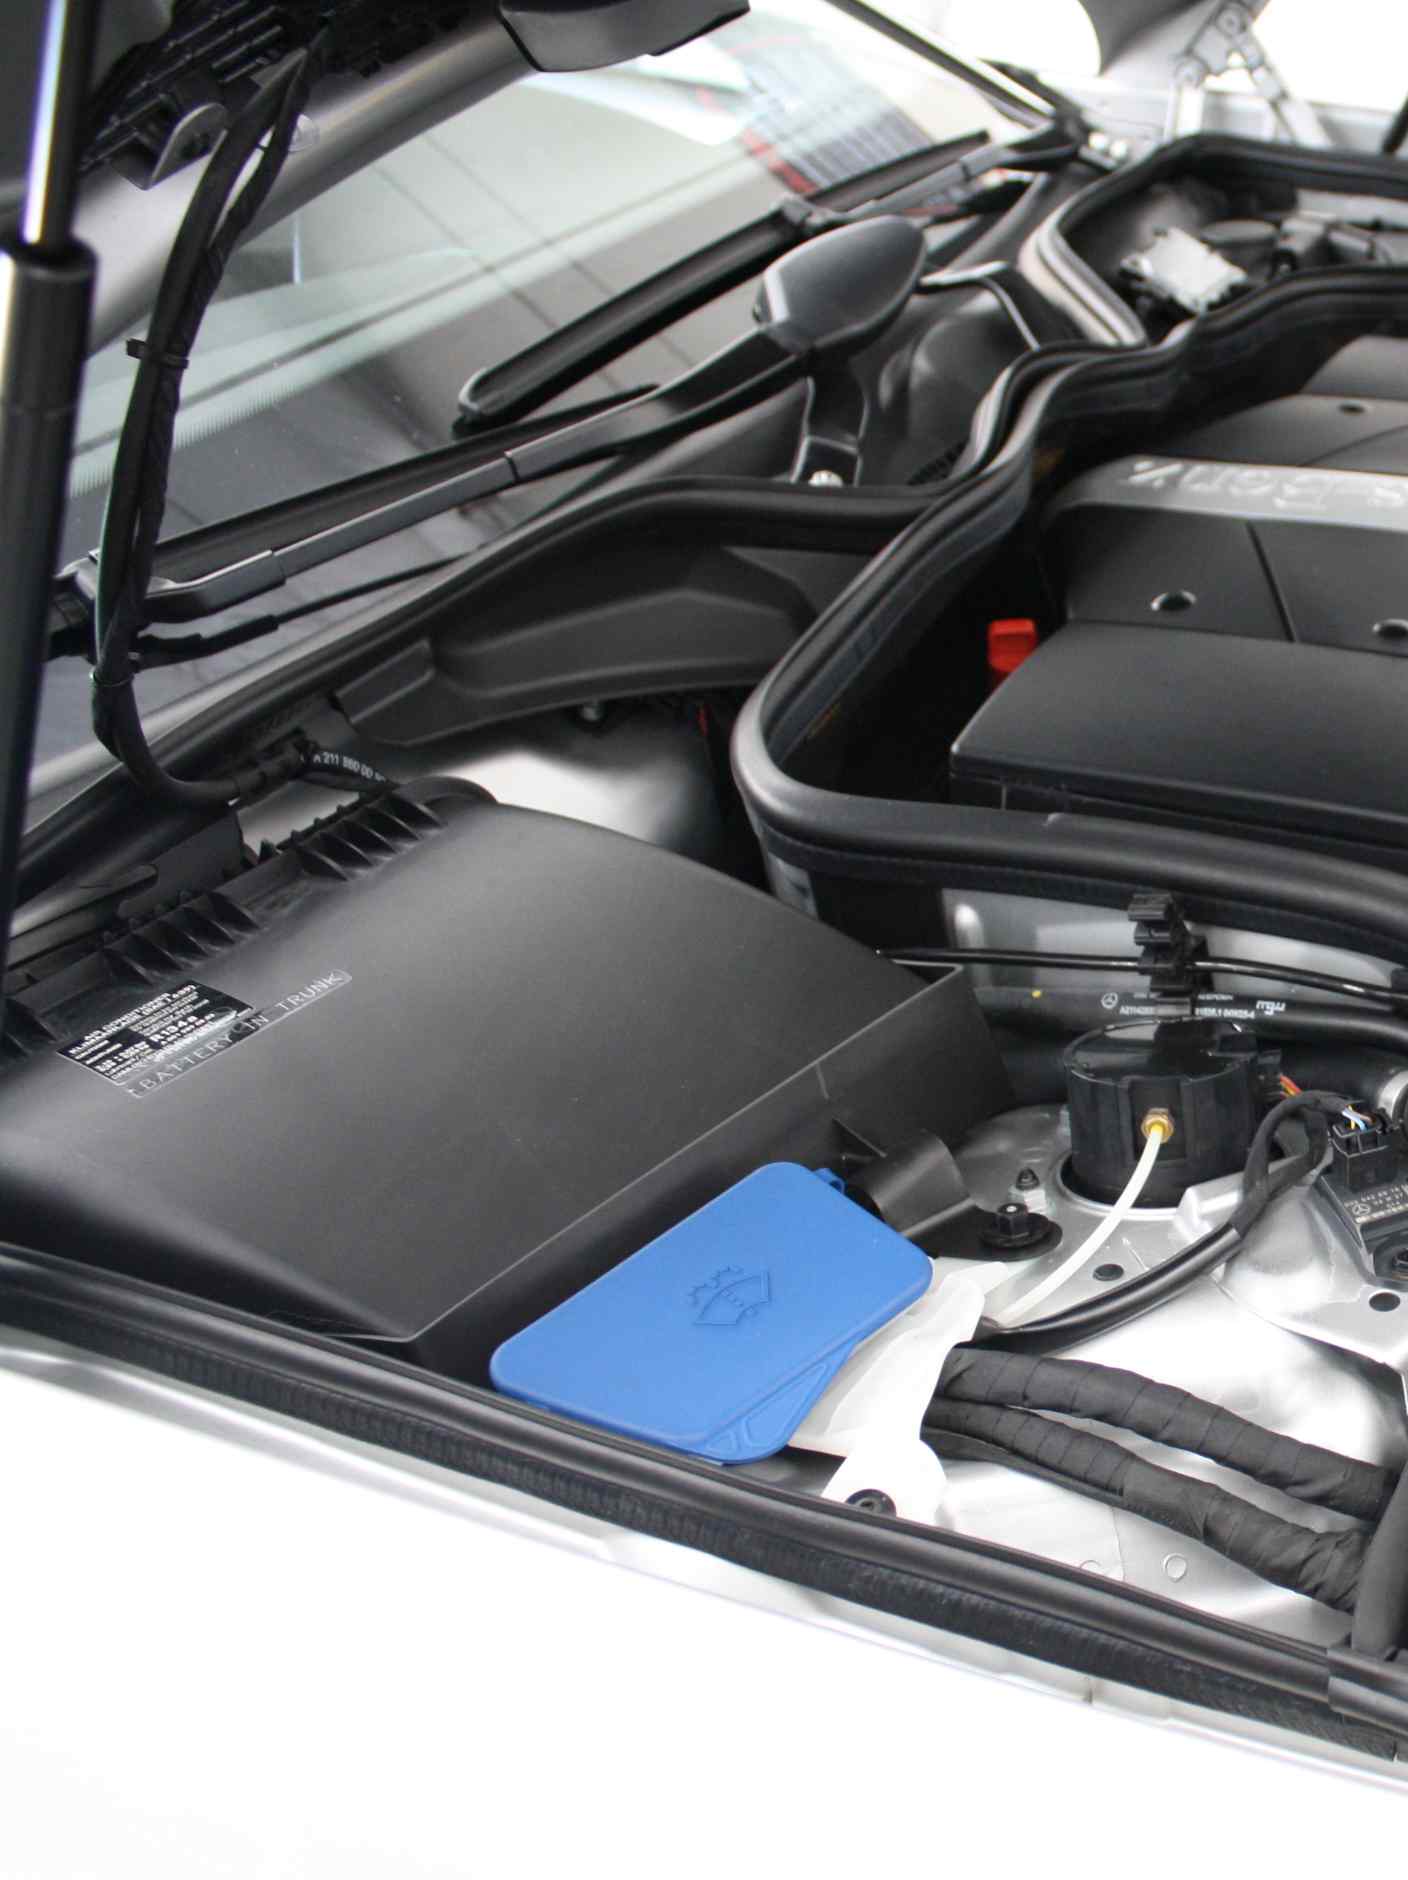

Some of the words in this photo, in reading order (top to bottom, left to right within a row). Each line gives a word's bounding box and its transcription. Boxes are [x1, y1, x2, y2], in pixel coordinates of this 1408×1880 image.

[139, 1032, 233, 1090] BATTERY
[248, 1013, 270, 1032] IN
[275, 970, 344, 1012] TRUNK
